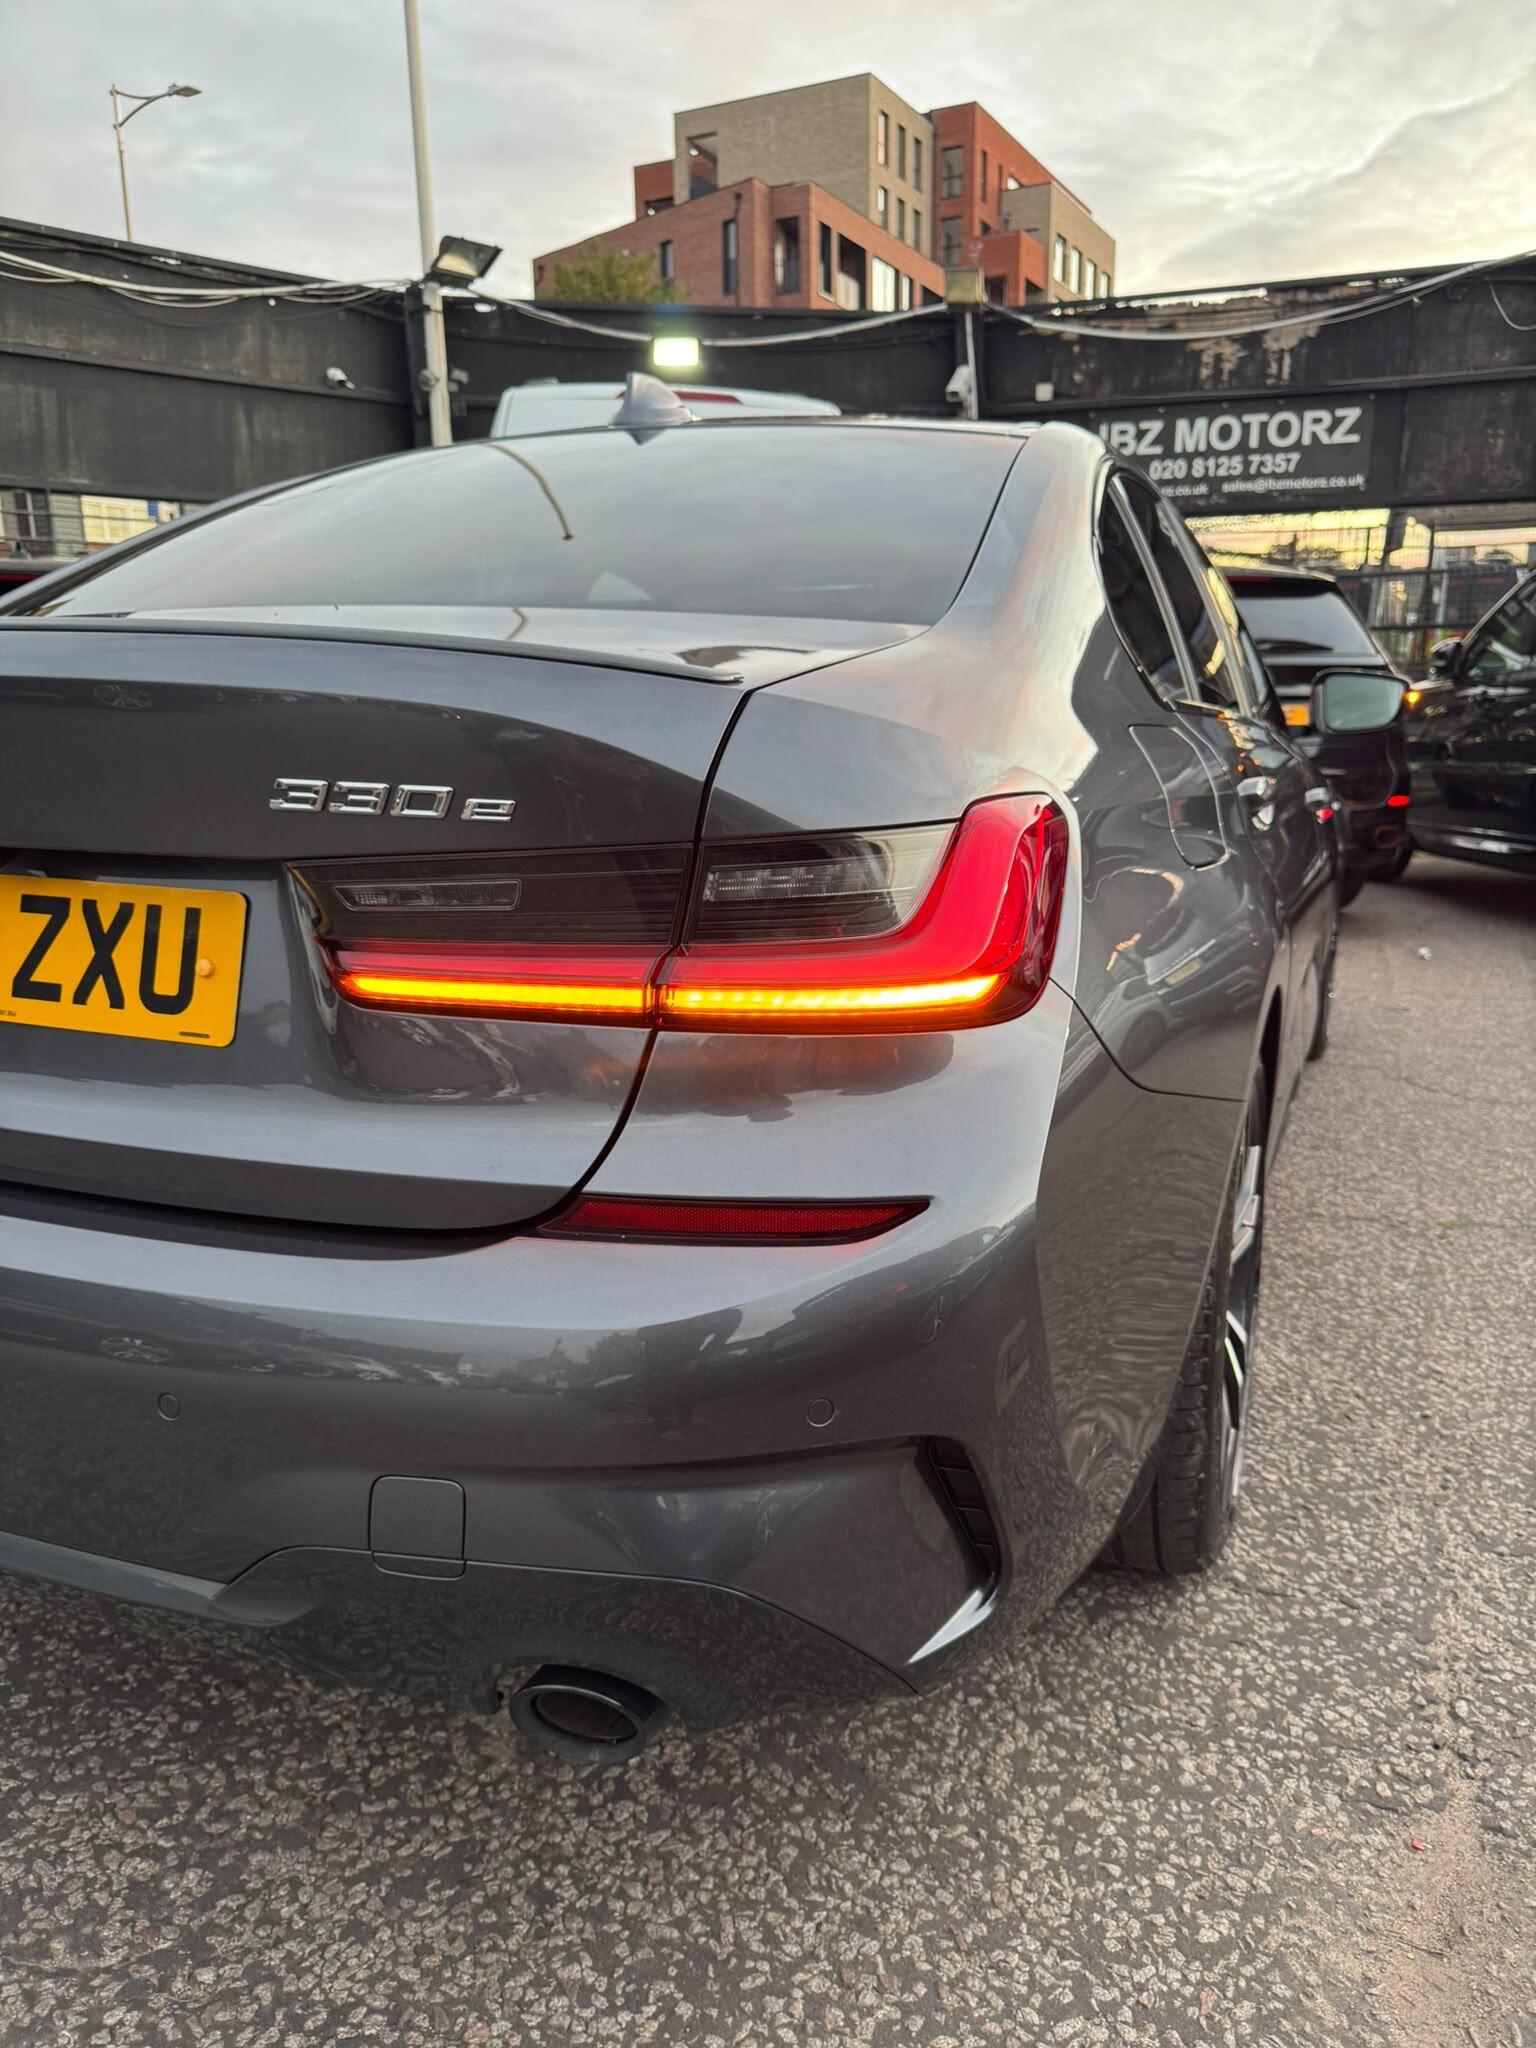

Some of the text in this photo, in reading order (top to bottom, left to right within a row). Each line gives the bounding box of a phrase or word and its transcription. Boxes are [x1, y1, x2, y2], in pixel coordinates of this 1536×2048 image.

[1174, 407, 1362, 453] MOTORZ
[1149, 452, 1300, 480] 020 8125 7357
[11, 893, 202, 1015] ZXU
